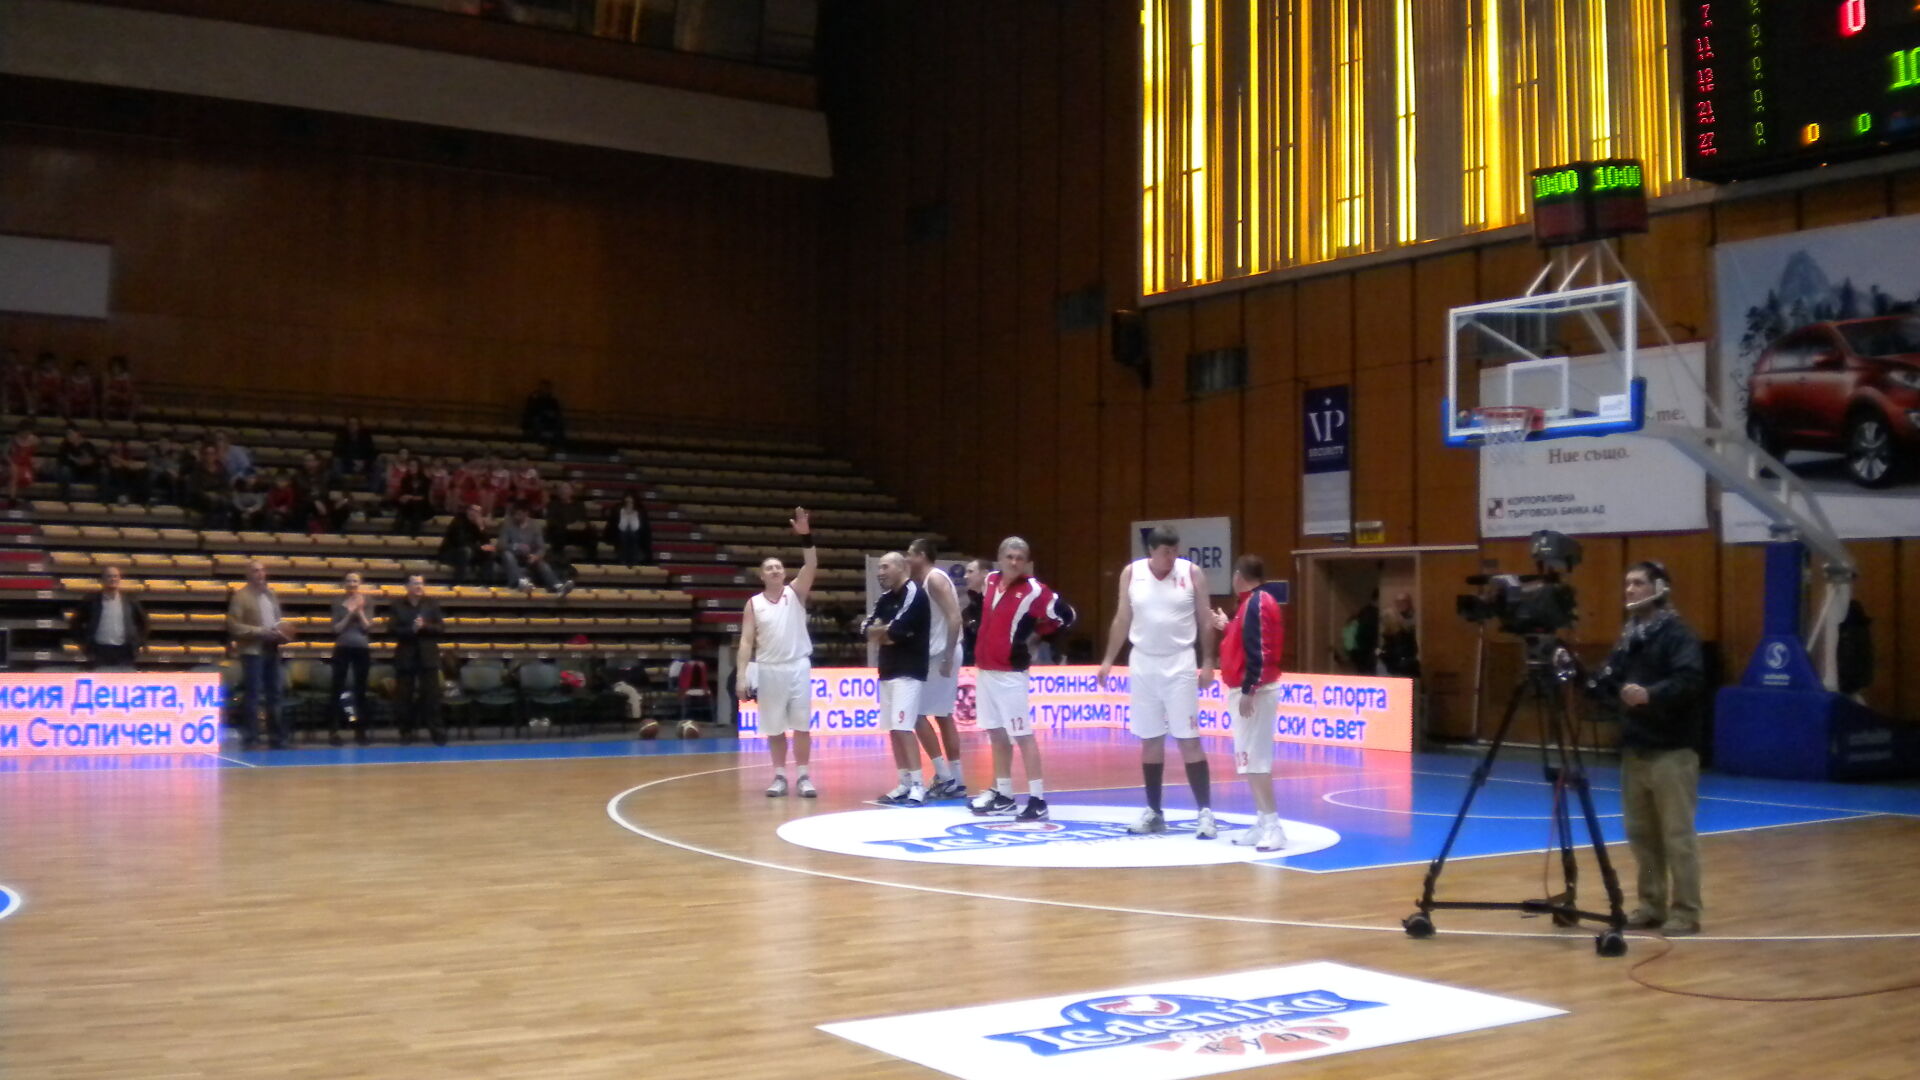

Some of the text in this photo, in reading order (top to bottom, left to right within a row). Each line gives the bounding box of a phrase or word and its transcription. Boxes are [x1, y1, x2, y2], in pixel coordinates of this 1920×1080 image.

[1701, 3, 1711, 19] 7
[1806, 122, 1820, 142] 0
[1856, 112, 1871, 133] 0
[1535, 169, 1579, 198] 10:00
[1592, 165, 1641, 191] 10:00
[1309, 397, 1345, 442] VIP
[70, 679, 185, 714] Децата,
[1323, 685, 1387, 714] спорта
[898, 710, 906, 724] 9
[1010, 717, 1025, 731] 12
[1311, 717, 1367, 740] съвет
[0, 724, 18, 747] и
[28, 717, 171, 747] Столичен
